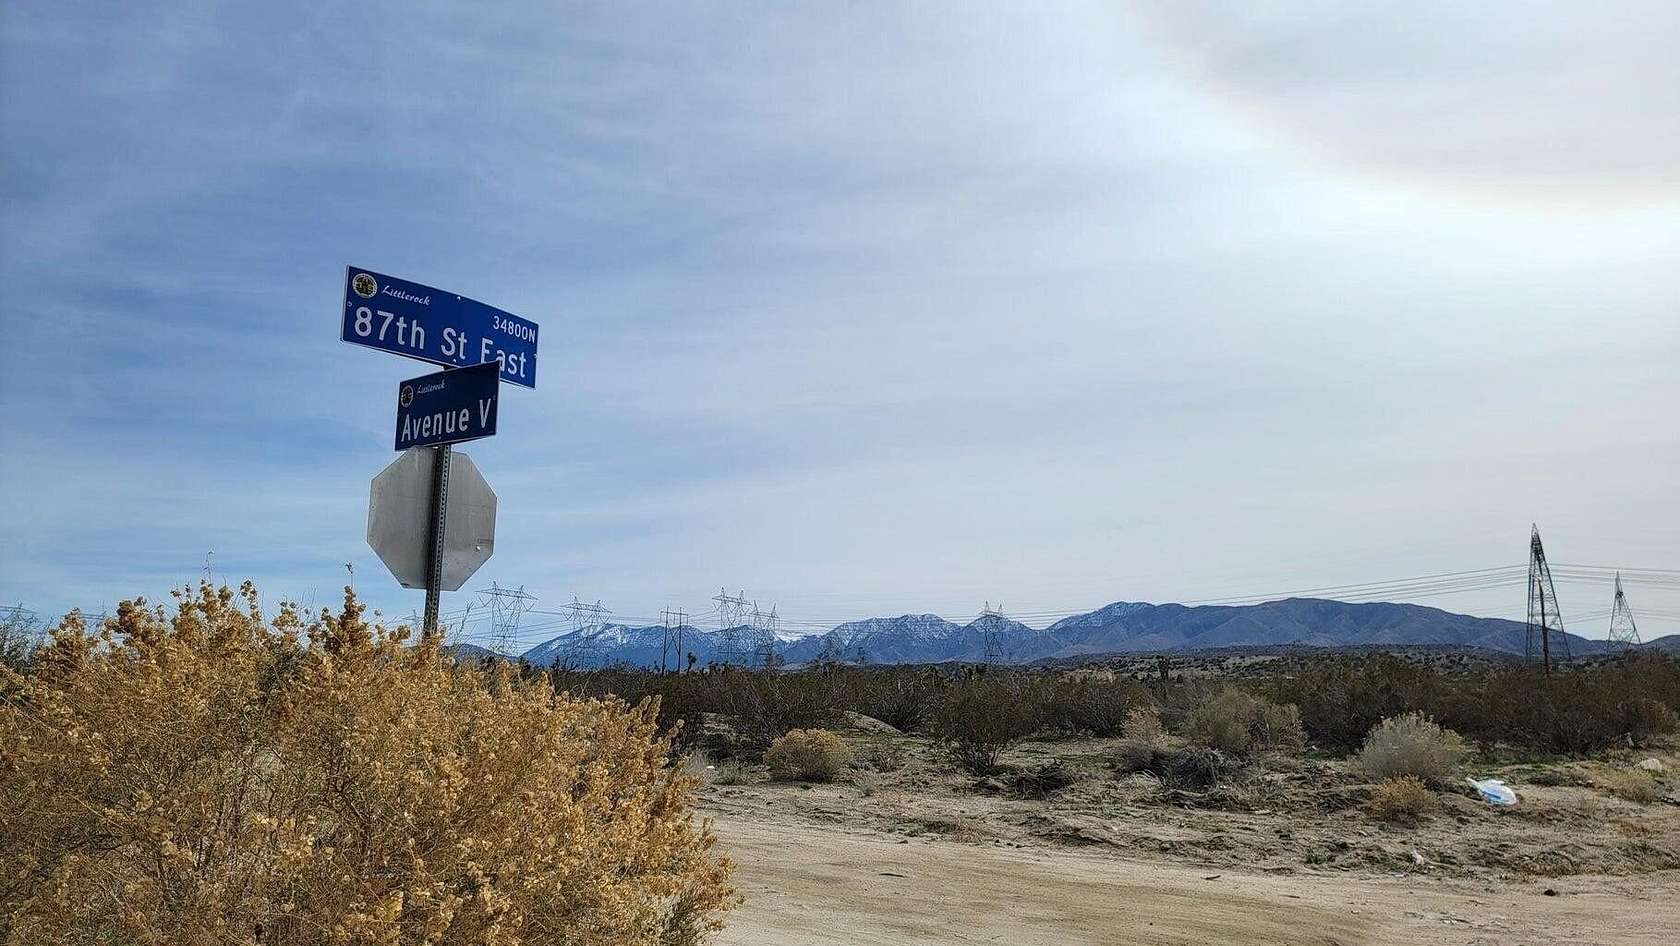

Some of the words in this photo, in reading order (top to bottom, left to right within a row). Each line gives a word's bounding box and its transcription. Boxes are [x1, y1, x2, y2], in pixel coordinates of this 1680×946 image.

[382, 285, 431, 306] Littlerock
[354, 306, 425, 350] 87th
[440, 327, 468, 360] St
[493, 315, 536, 344] 34800N
[400, 408, 469, 442] Avenue
[479, 398, 492, 429] V
